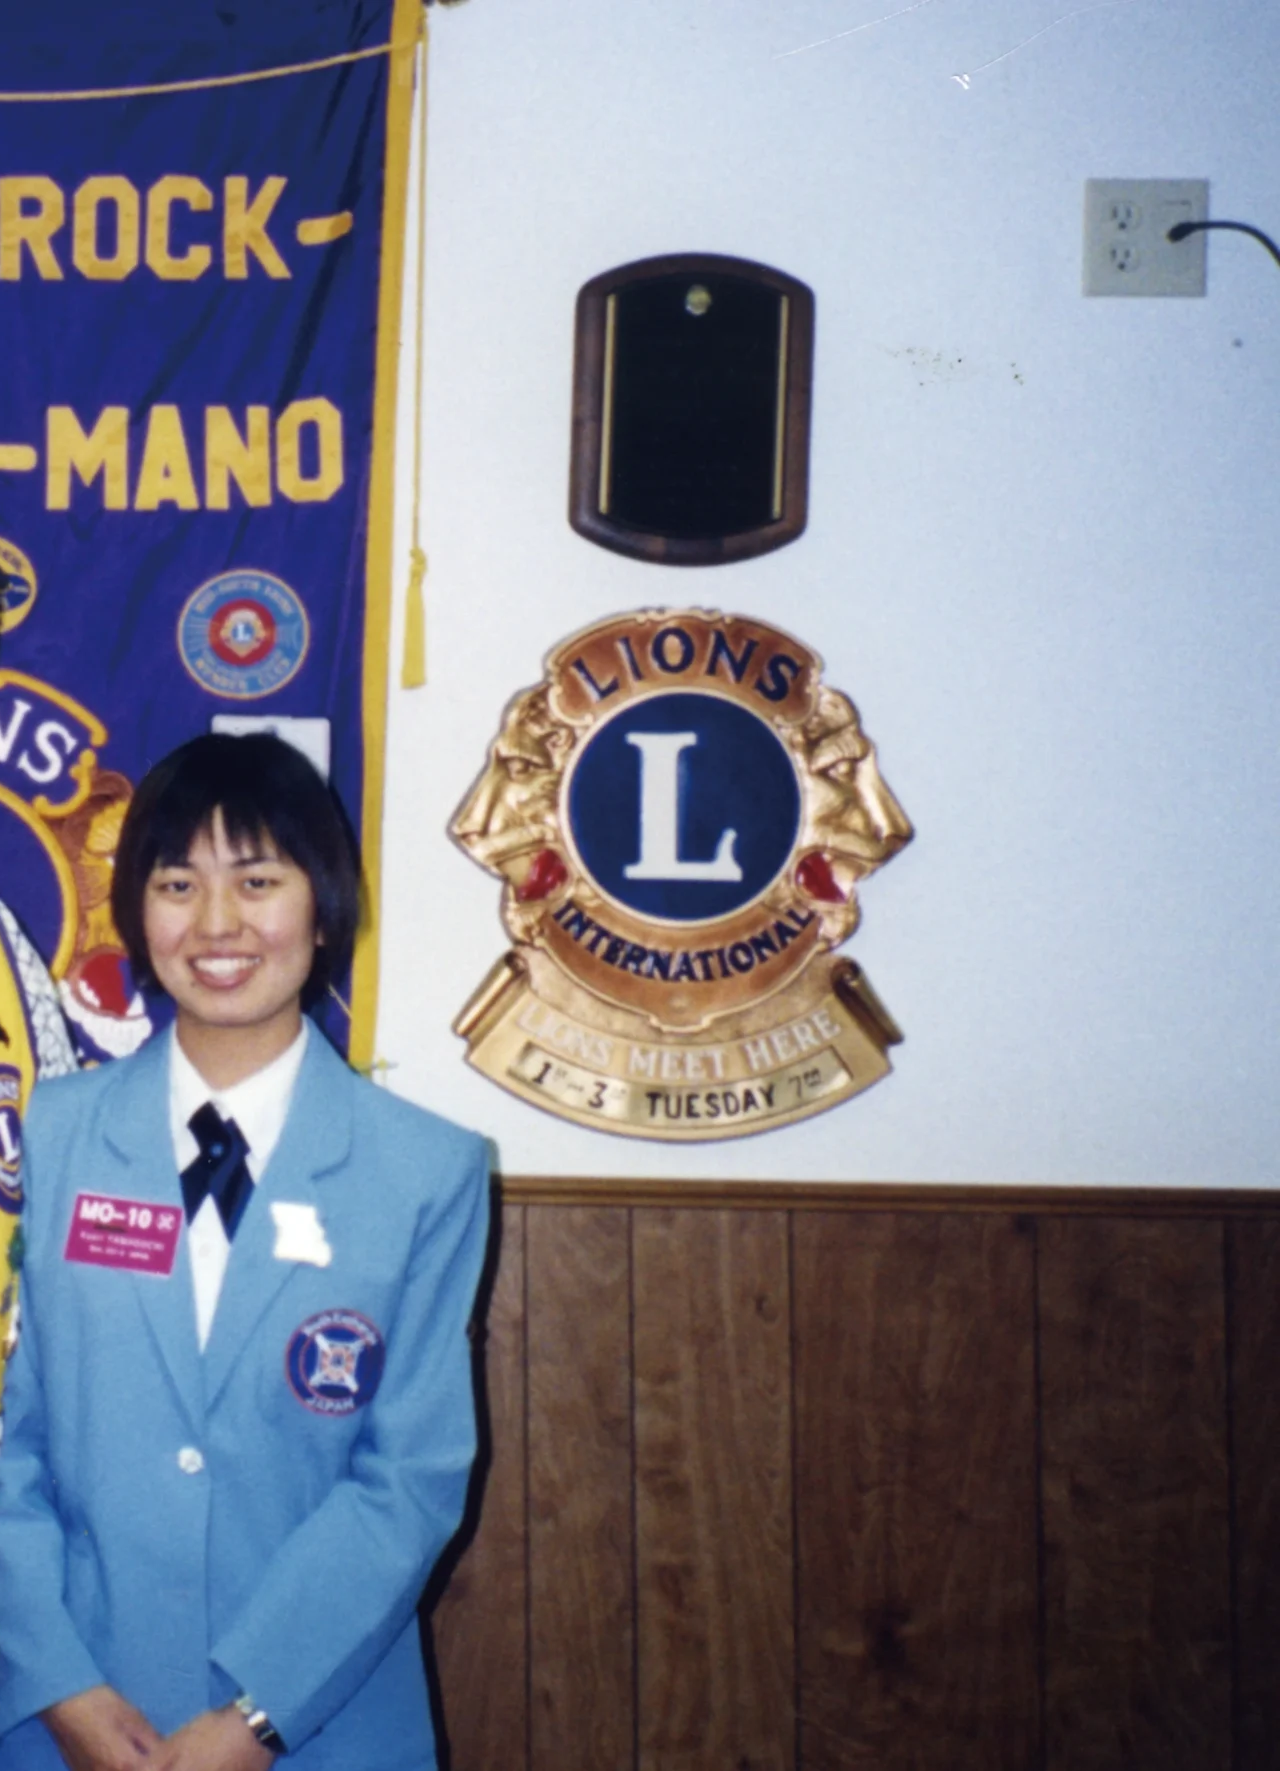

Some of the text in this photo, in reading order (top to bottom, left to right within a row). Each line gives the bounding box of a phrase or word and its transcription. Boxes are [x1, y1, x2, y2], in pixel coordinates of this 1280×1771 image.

[573, 627, 802, 702] LIONS
[623, 731, 743, 882] L
[552, 898, 816, 983] INTERNATIONAL
[517, 1002, 842, 1079] LIONS MEET HERE
[645, 1084, 776, 1120] TUESDAY
[80, 1199, 153, 1230] MO-10
